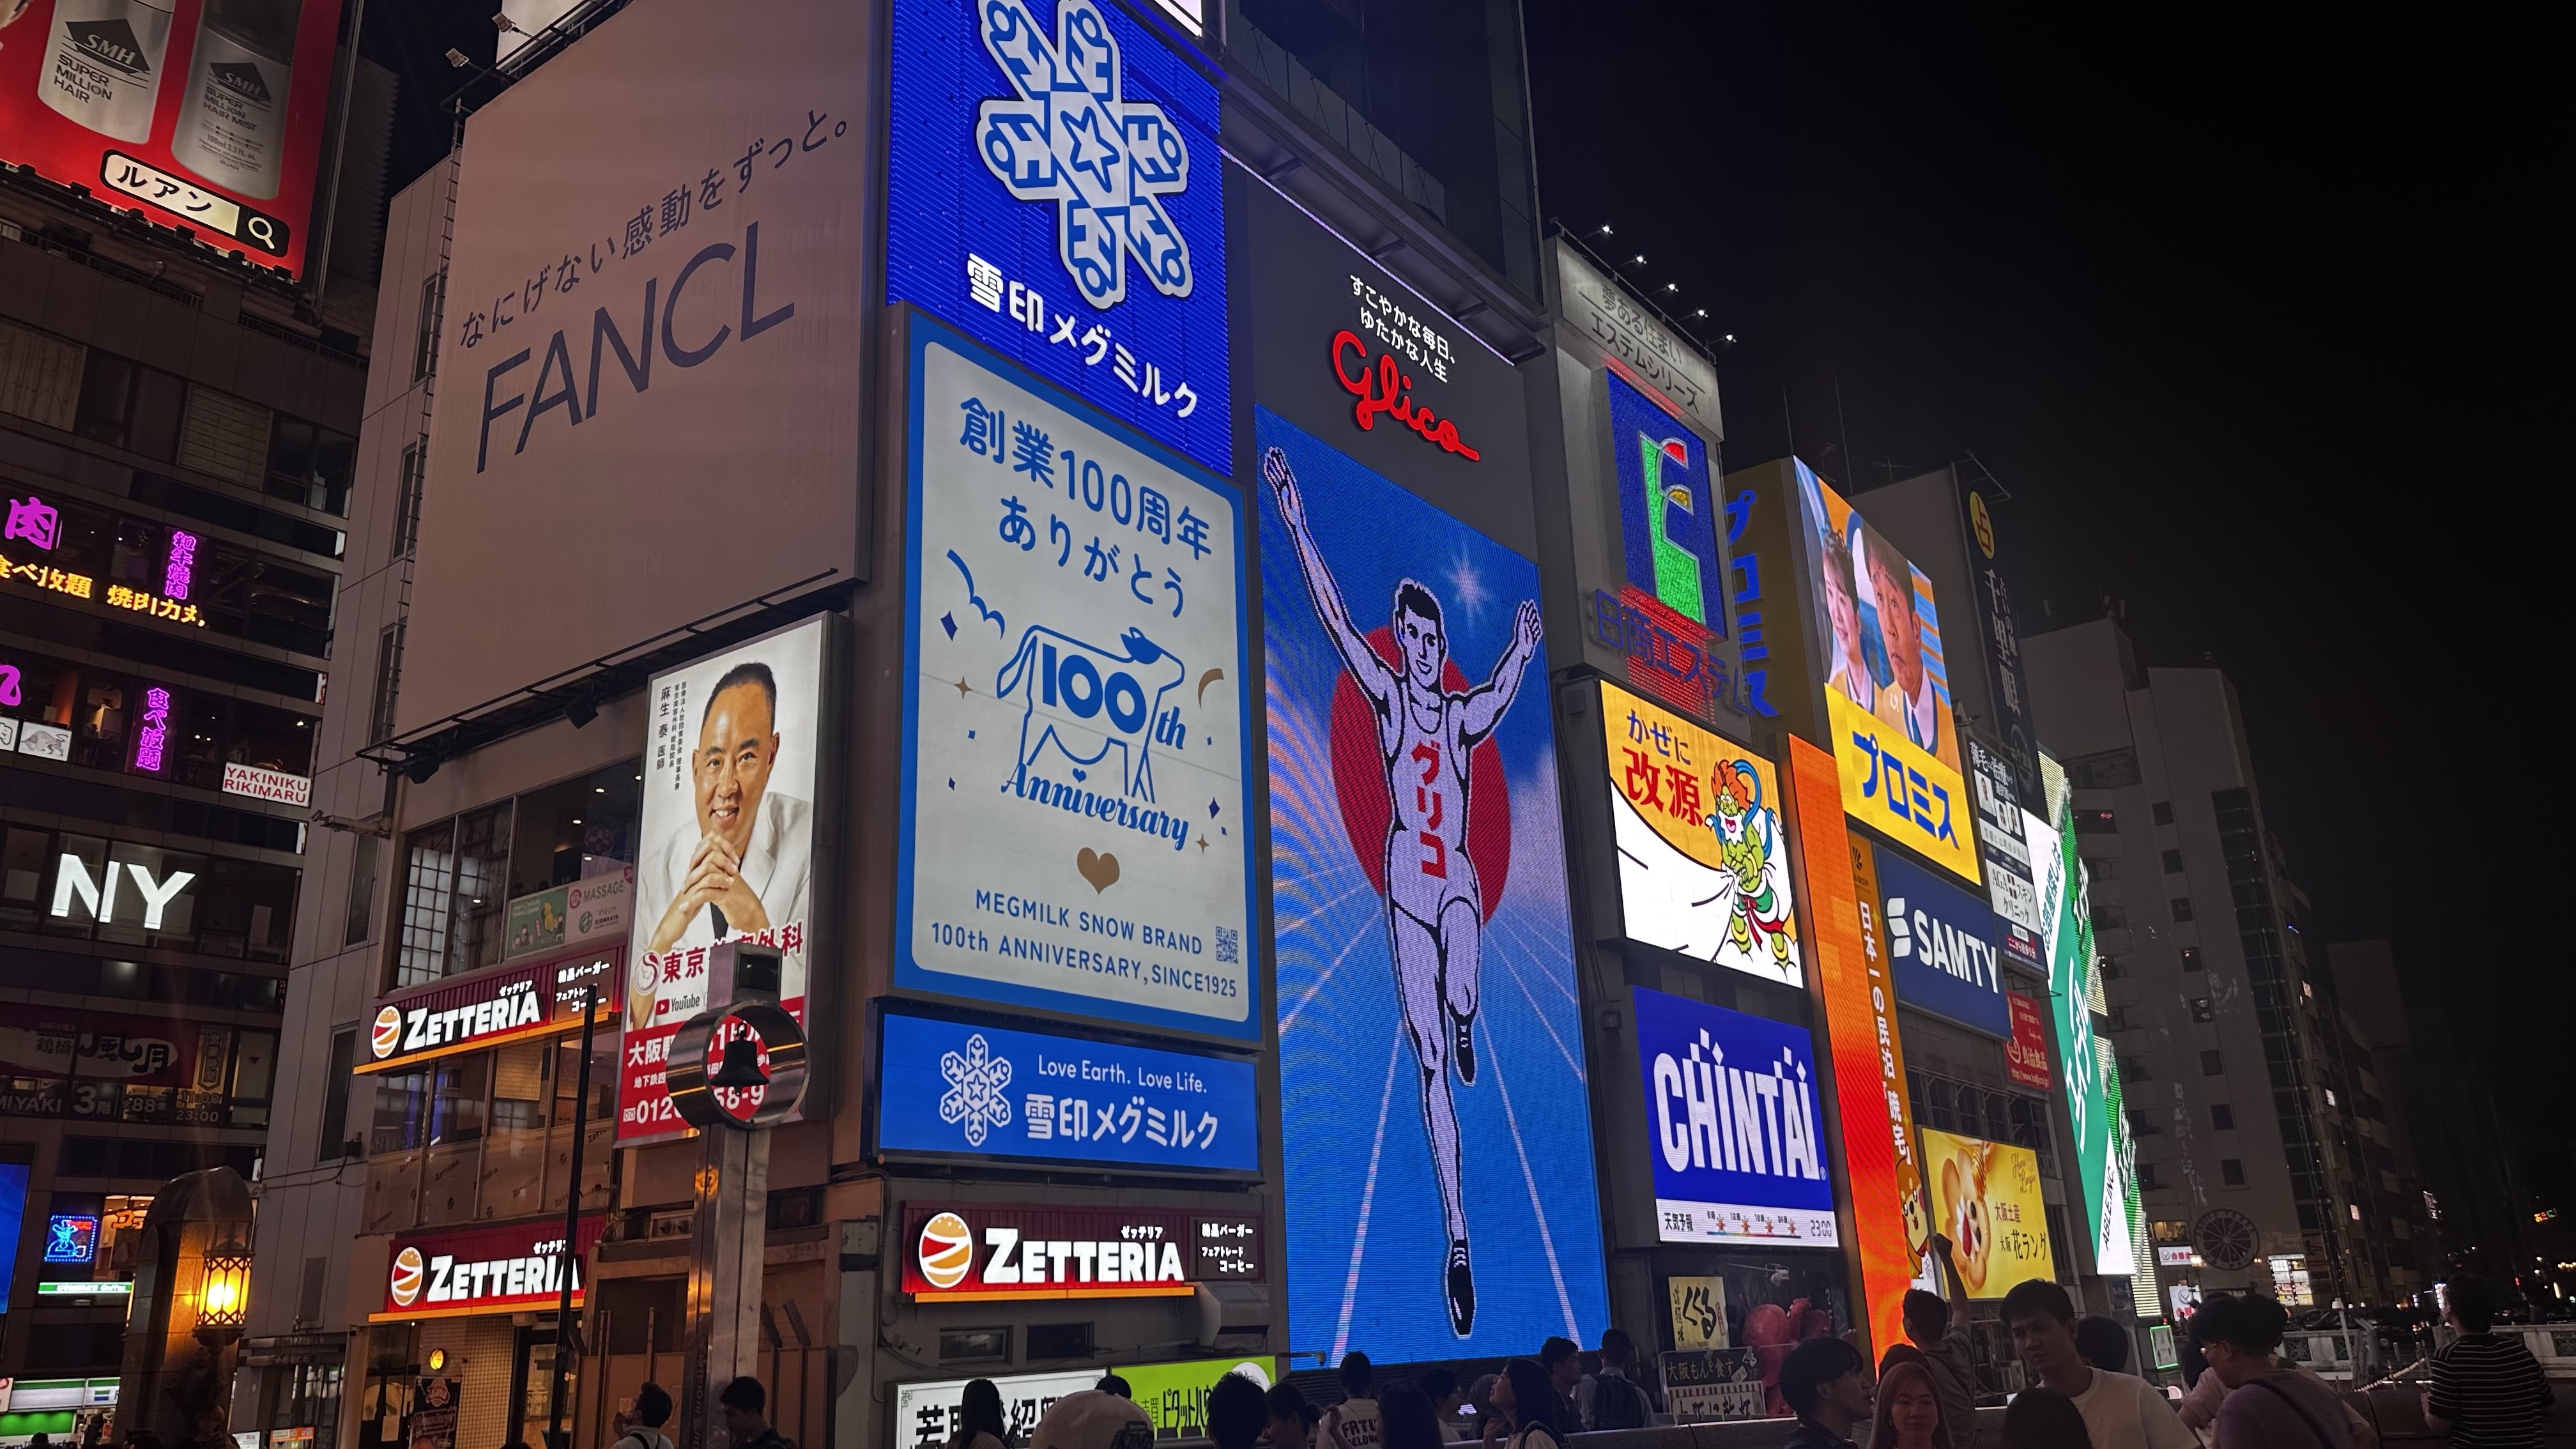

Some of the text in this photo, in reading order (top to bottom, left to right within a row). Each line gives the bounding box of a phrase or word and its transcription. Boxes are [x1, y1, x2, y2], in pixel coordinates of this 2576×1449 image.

[57, 53, 110, 88] SUPER
[82, 32, 135, 66] SMH
[53, 75, 90, 104] HAIR
[56, 63, 112, 100] MILLION
[204, 94, 246, 119] MILLION
[205, 86, 243, 110] SUPER
[225, 72, 261, 95] SMH
[203, 102, 257, 131] HAIR MIST
[117, 164, 212, 213] ルアン
[460, 109, 847, 348] なにげない感動をずっと。
[967, 252, 1198, 418] 雪印メグミルク
[1350, 275, 1455, 364] すこやかな毎日、
[1360, 307, 1448, 383] ゆたかな人生
[477, 220, 795, 475] FANCL
[1590, 311, 1699, 414] エステムシリーズ
[1332, 330, 1480, 461] Glico
[960, 397, 1212, 560] 創業100周年
[5, 496, 58, 550] 肉
[1974, 496, 1993, 554] 占
[999, 495, 1184, 618] ありがとう
[1725, 489, 1779, 717] プロミス
[1984, 567, 2021, 719] 千里眼
[659, 686, 671, 717] 麻生
[657, 744, 666, 771] 医師
[1627, 709, 1691, 766] かぜに
[224, 778, 307, 804] RIKIMARU
[226, 767, 308, 793] YAKINIKU
[1622, 746, 1704, 827] 改源
[1851, 730, 1961, 850] プロミス
[1001, 763, 1190, 851] Anniversary
[1411, 740, 1447, 880] グリコ
[51, 853, 195, 930] NY
[583, 879, 625, 903] MASSAGE
[1992, 868, 2032, 905] AGA スキン
[2003, 899, 2029, 925] クリニック
[931, 922, 989, 953] 100th
[976, 889, 1202, 955] MEGMILK SNOW BRAND
[1913, 908, 2000, 995] SAMTY
[499, 980, 533, 997] ゼッテリア
[671, 993, 700, 1012] YouTube
[403, 990, 540, 1052] ZETTERIA
[1038, 1054, 1208, 1094] Love Earth. Love Life.
[176, 1110, 220, 1123] 23:00
[1025, 1093, 1218, 1150] 雪印メグミルク
[1653, 1027, 1820, 1181] CHINTAI
[1121, 1224, 1163, 1240] ゼッテリア
[1664, 1211, 1694, 1232] 天気予報
[1995, 1201, 2021, 1223] 大阪土産
[983, 1227, 1185, 1284] ZETTERIA
[1218, 1259, 1254, 1274] コーヒー
